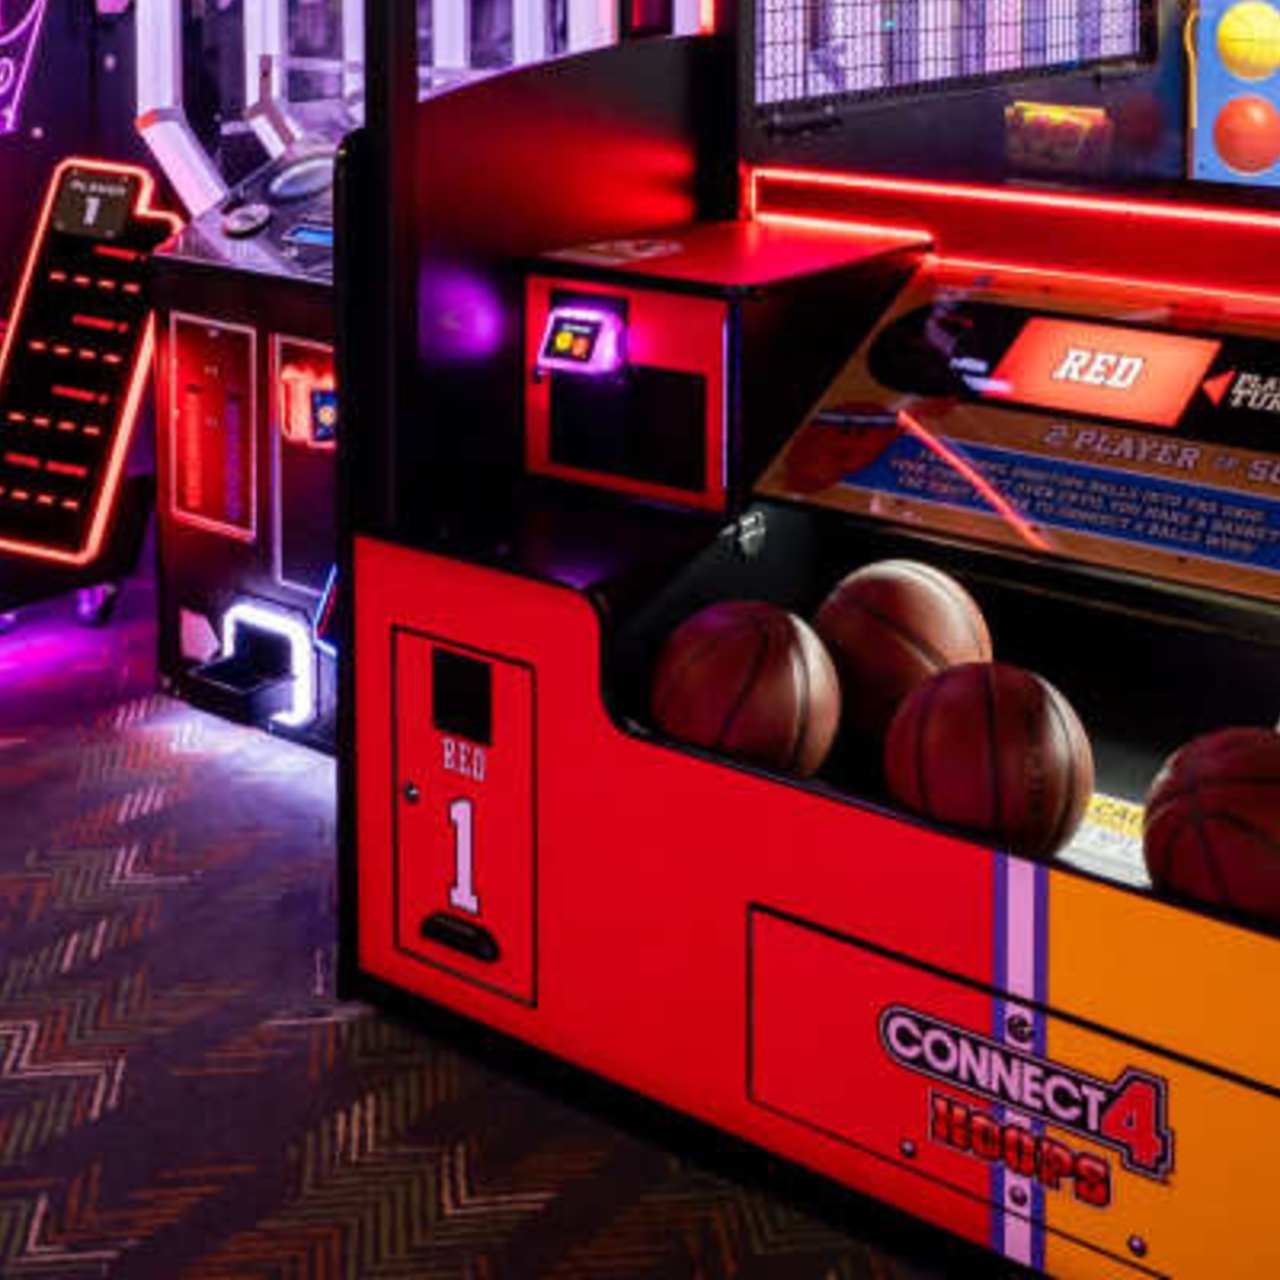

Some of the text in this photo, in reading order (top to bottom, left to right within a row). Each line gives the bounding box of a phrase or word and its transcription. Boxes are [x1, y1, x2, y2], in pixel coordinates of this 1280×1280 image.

[82, 197, 100, 226] 1
[1050, 346, 1145, 391] RED
[1043, 424, 1070, 448] 2
[1073, 428, 1202, 471] PLAYER
[443, 738, 486, 781] RED
[450, 798, 479, 915] 1
[885, 1016, 1165, 1170] CONNECT 4
[930, 1094, 1112, 1207] HOOPS
